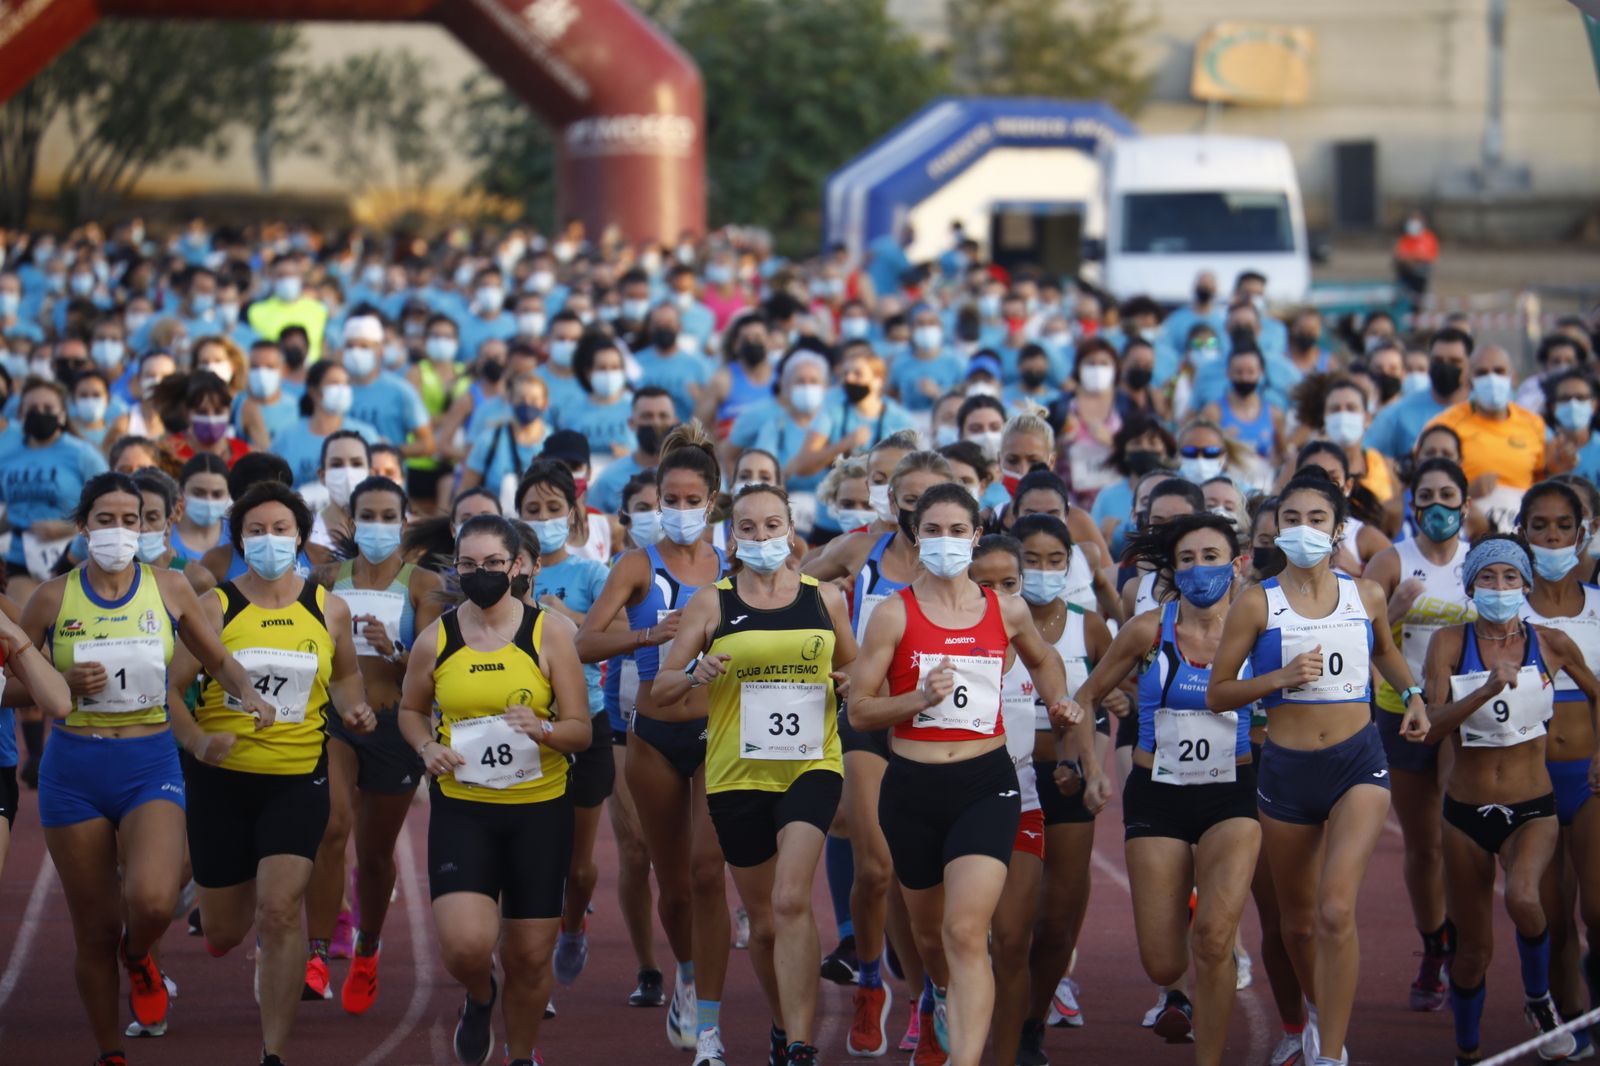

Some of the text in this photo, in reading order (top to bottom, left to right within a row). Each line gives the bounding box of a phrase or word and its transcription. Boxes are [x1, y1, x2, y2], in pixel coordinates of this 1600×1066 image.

[59, 629, 86, 638] Vopak
[114, 668, 126, 690] 1
[736, 664, 818, 678] CLUB ATLETISMO
[254, 675, 288, 696] 47
[953, 685, 968, 708] 6
[1492, 700, 1510, 723] 9
[768, 713, 800, 736] 33
[481, 743, 513, 768] 48
[1178, 738, 1210, 762] 20
